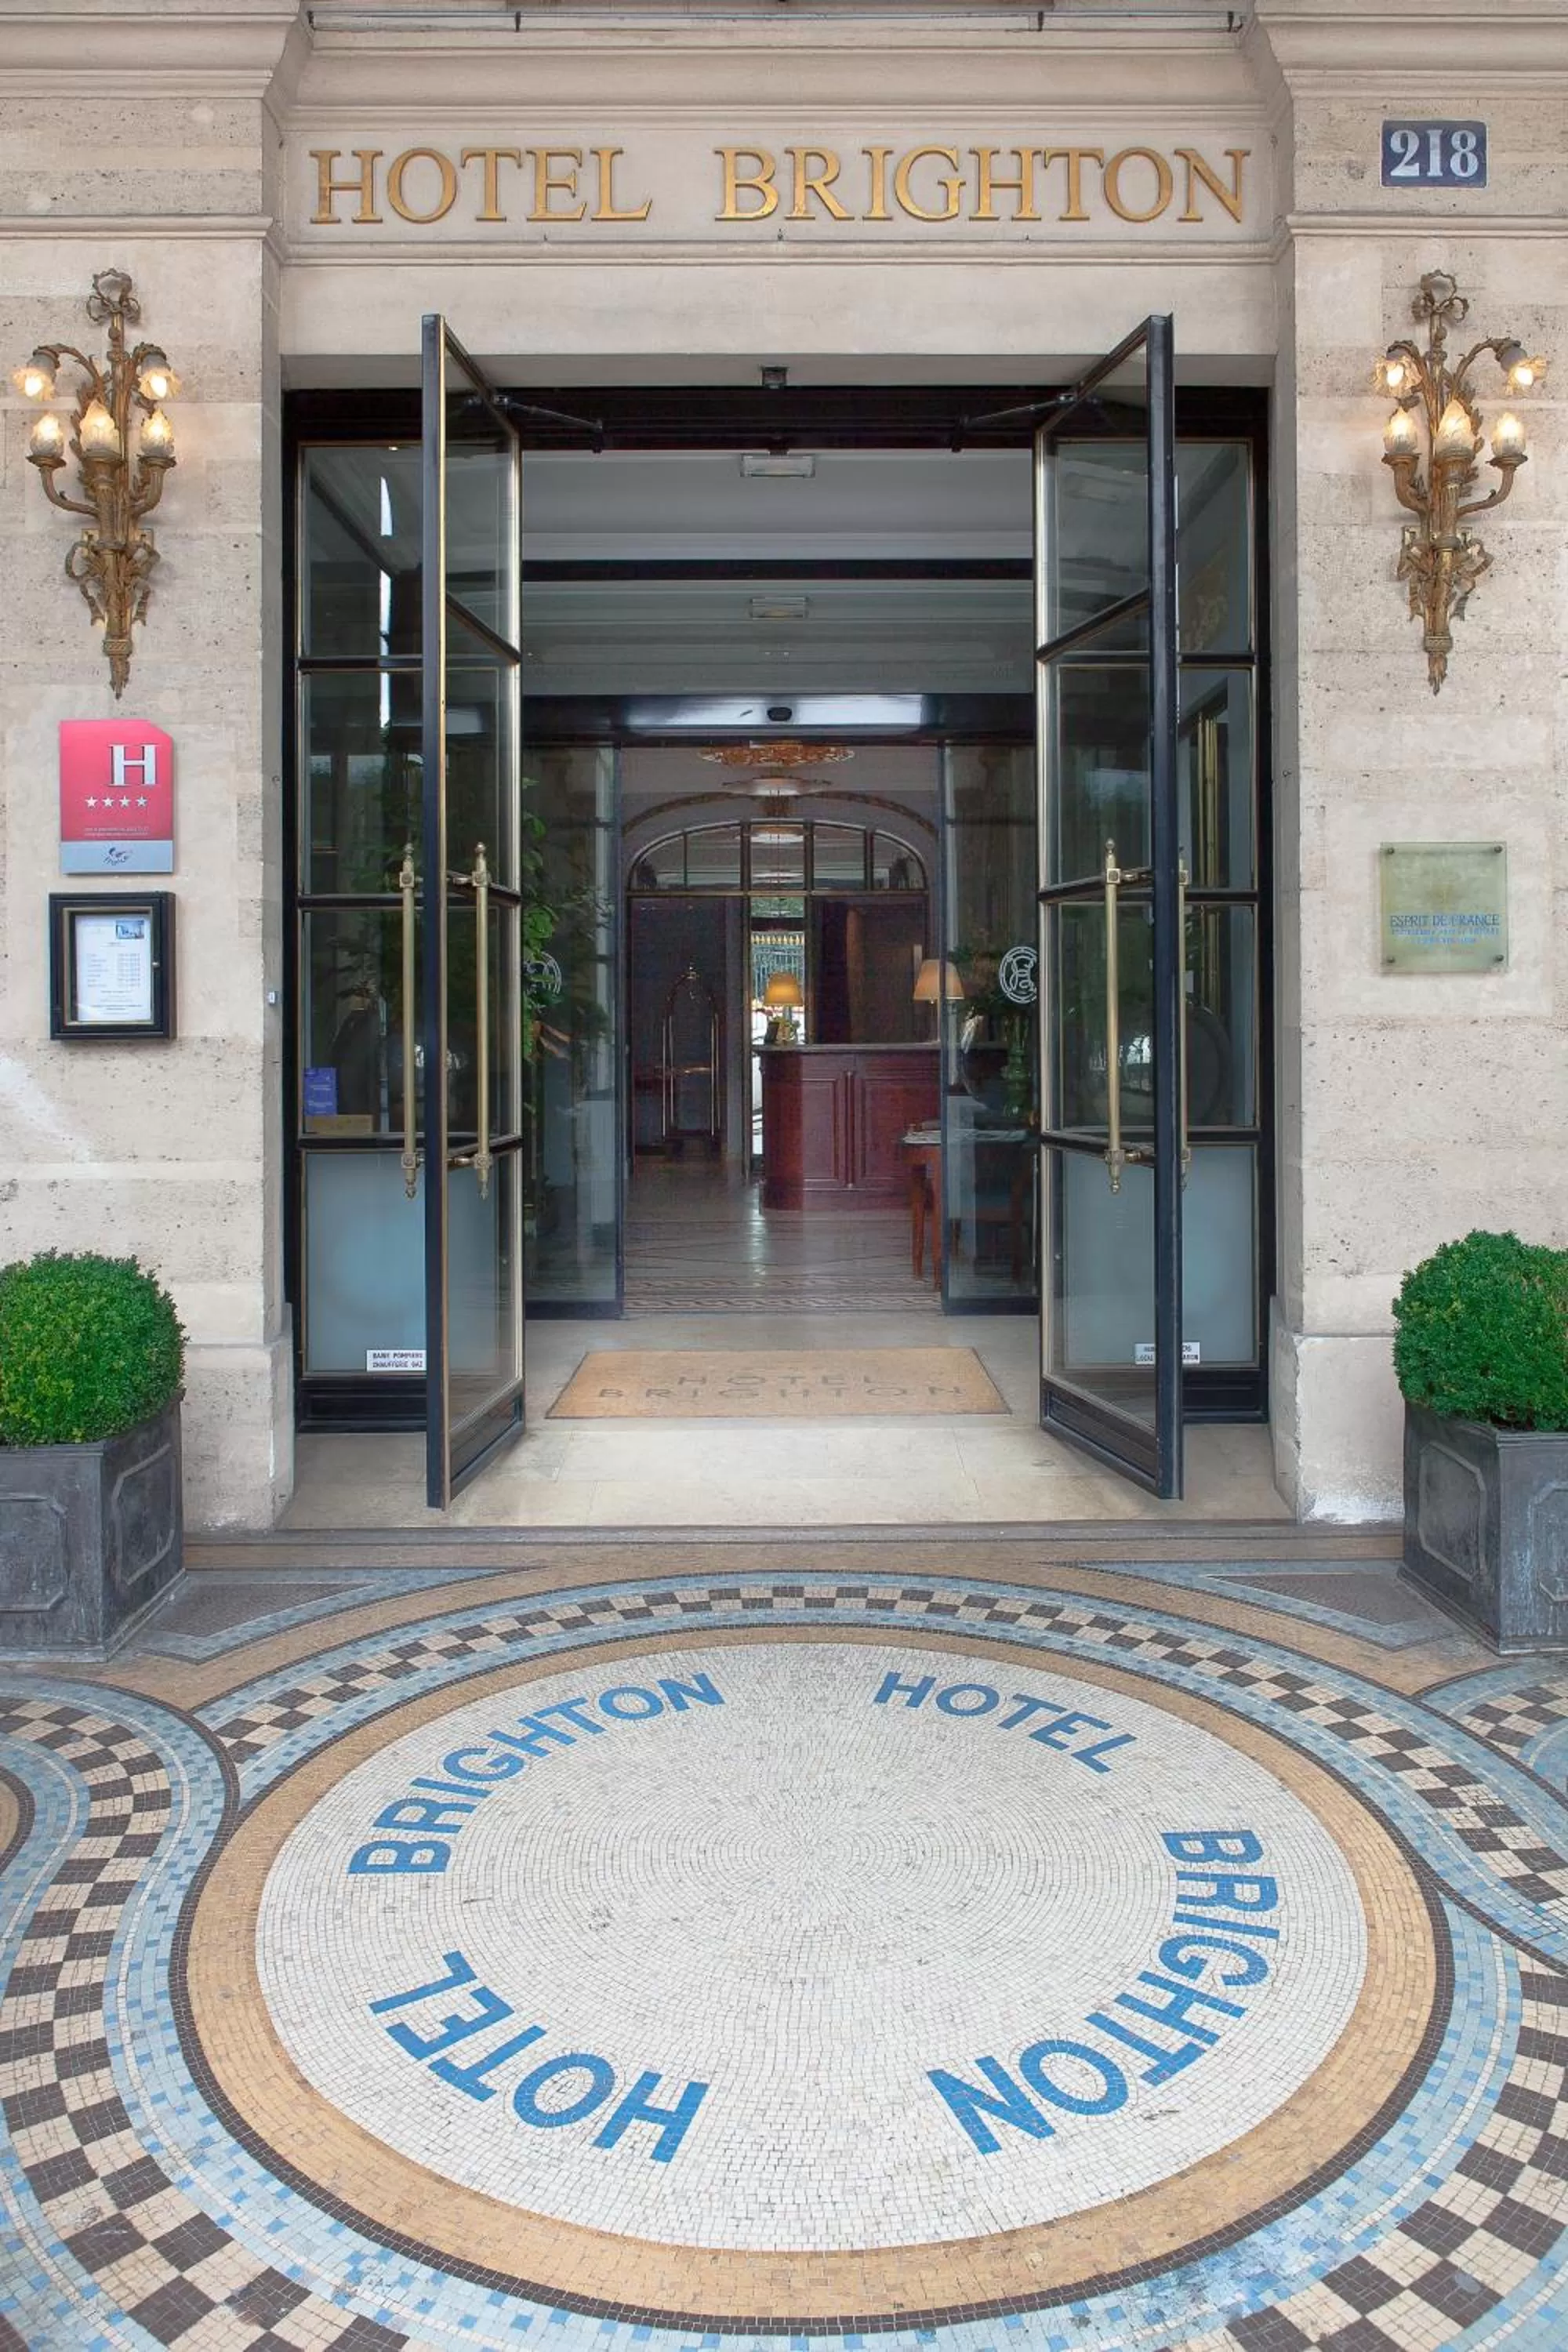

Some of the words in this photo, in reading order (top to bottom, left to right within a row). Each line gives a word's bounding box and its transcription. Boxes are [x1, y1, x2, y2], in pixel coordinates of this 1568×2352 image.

[1390, 129, 1479, 177] 218
[309, 147, 653, 224] HOTEL
[713, 147, 1251, 223] BRIGHTON
[107, 742, 158, 787] H
[1390, 915, 1429, 927] ESPRIT
[1432, 915, 1448, 927] DE
[1451, 913, 1501, 927] FRANCE
[599, 1385, 963, 1399] BRIGHTON
[677, 1375, 884, 1386] HOTEL
[875, 1673, 1138, 1773] HOTEL
[349, 1673, 723, 1874] BRIGHTON
[927, 1828, 1280, 2156] BRIGHTON
[369, 1951, 710, 2164] HOTEL
